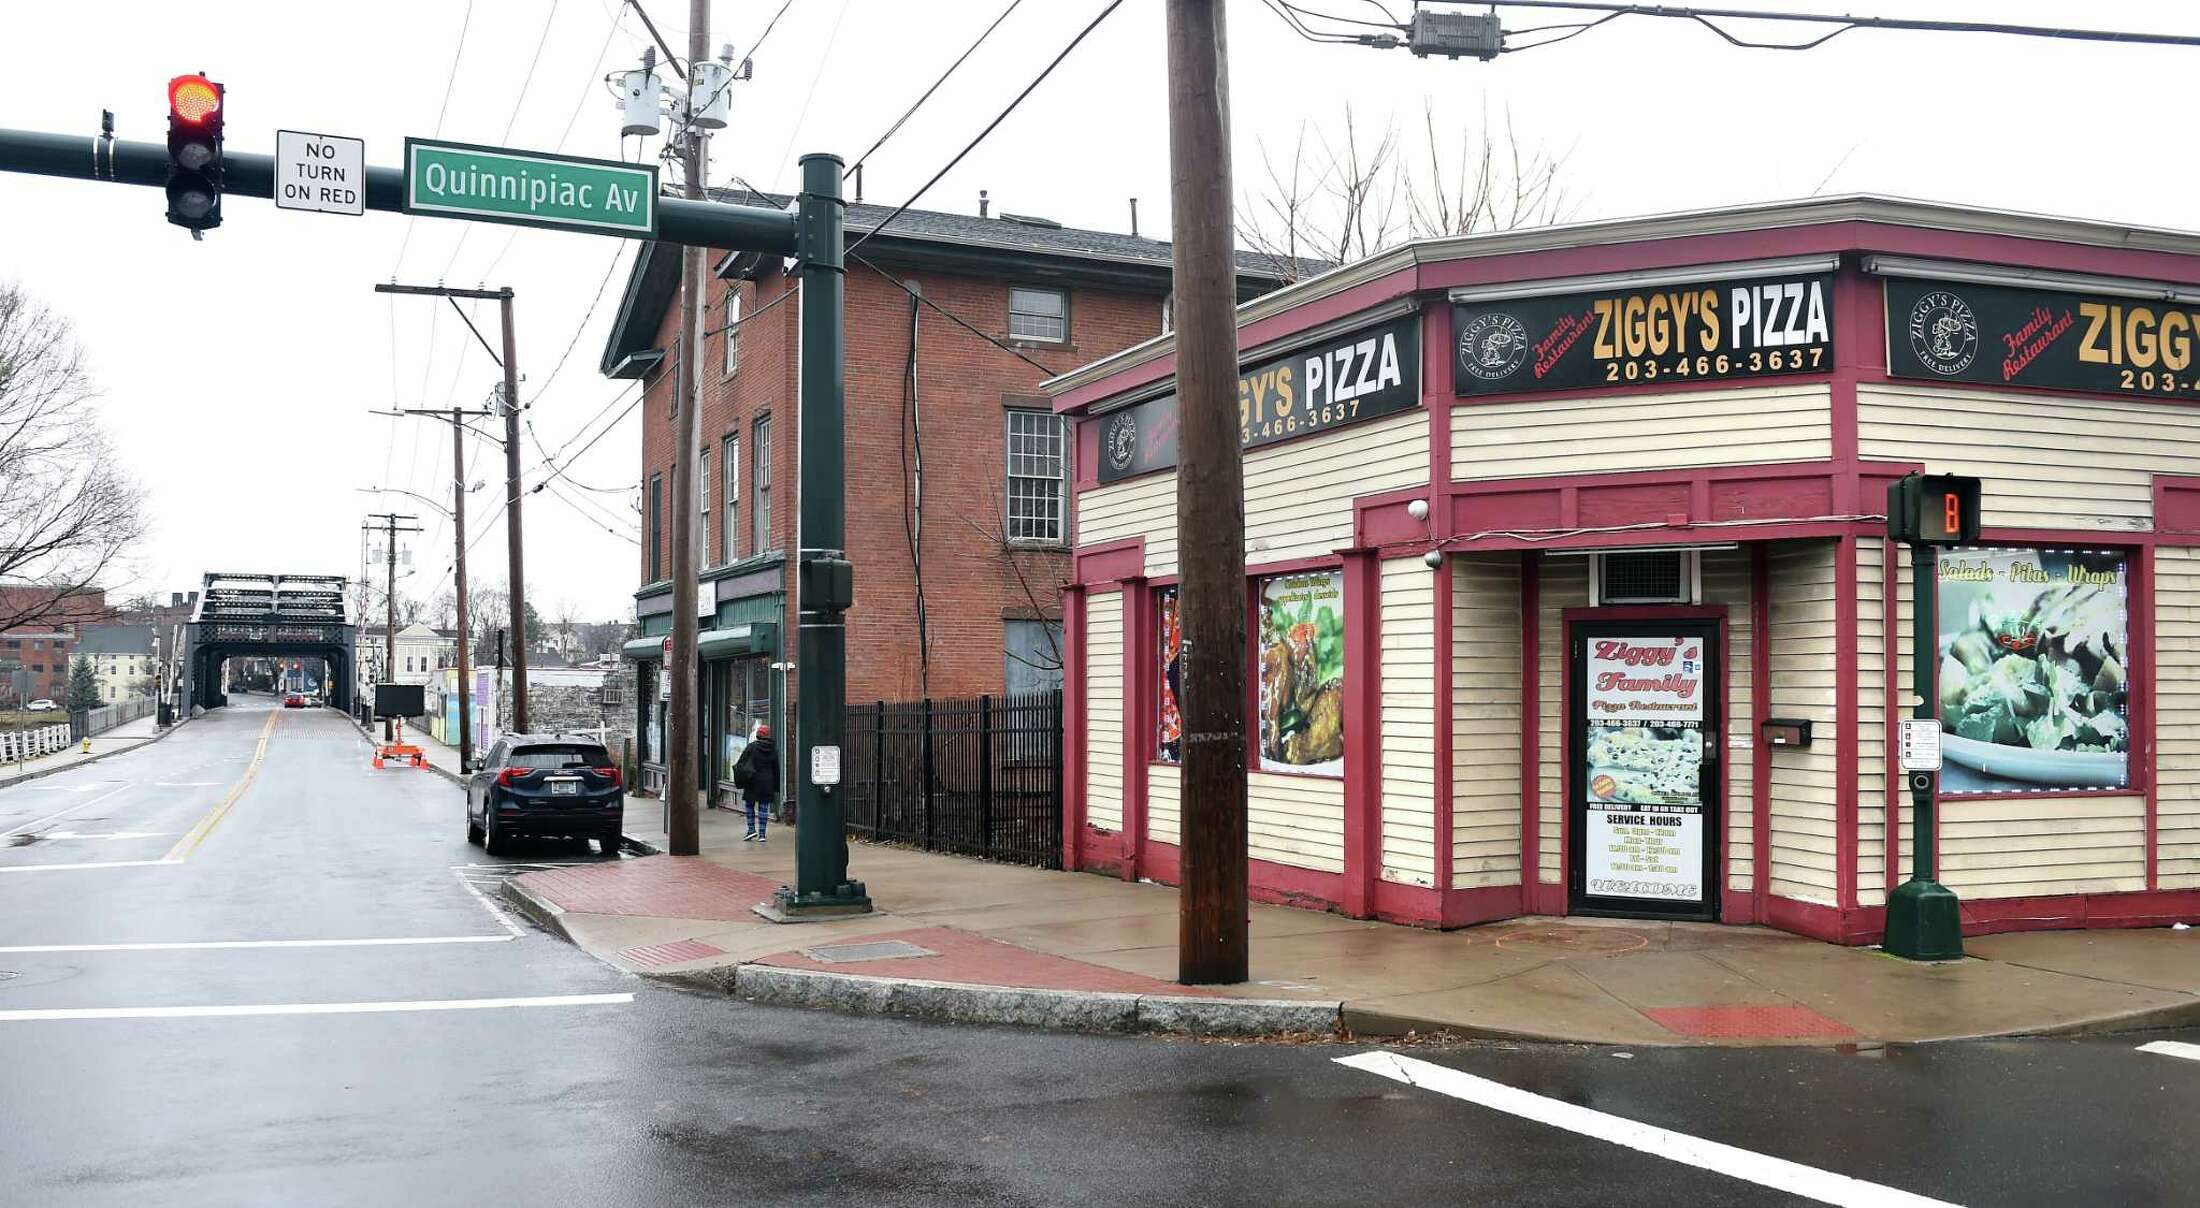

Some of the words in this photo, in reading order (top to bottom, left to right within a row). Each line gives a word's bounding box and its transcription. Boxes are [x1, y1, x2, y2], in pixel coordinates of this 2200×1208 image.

[296, 163, 346, 182] TURN
[305, 143, 336, 160] NO
[284, 184, 311, 201] ON
[319, 188, 356, 205] RED
[424, 162, 594, 211] Quinnipiac
[604, 184, 639, 214] Av
[1532, 314, 1576, 361] Family
[1593, 288, 1721, 360] ZIGGY'S
[1731, 280, 1830, 349] PIZZA
[1911, 294, 1949, 340] ZIGGY'S
[1951, 299, 1977, 342] PIZZA
[2002, 306, 2053, 358] Family
[1534, 309, 1595, 379] Restaurant
[1606, 347, 1823, 382] 203-466-3637
[2003, 309, 2073, 381] Restaurant
[1239, 366, 1293, 428] GY'S
[1305, 332, 1402, 410] PIZZA
[1240, 399, 1360, 444] 3-466-3637
[1939, 558, 1994, 583] Salads
[2009, 561, 2050, 583] Pitas
[2067, 563, 2117, 592] Wraps
[1594, 635, 1699, 667] Ziggy's
[1595, 671, 1698, 699] Family
[1607, 814, 1646, 825] SERVICE
[1649, 816, 1682, 827] HOURS
